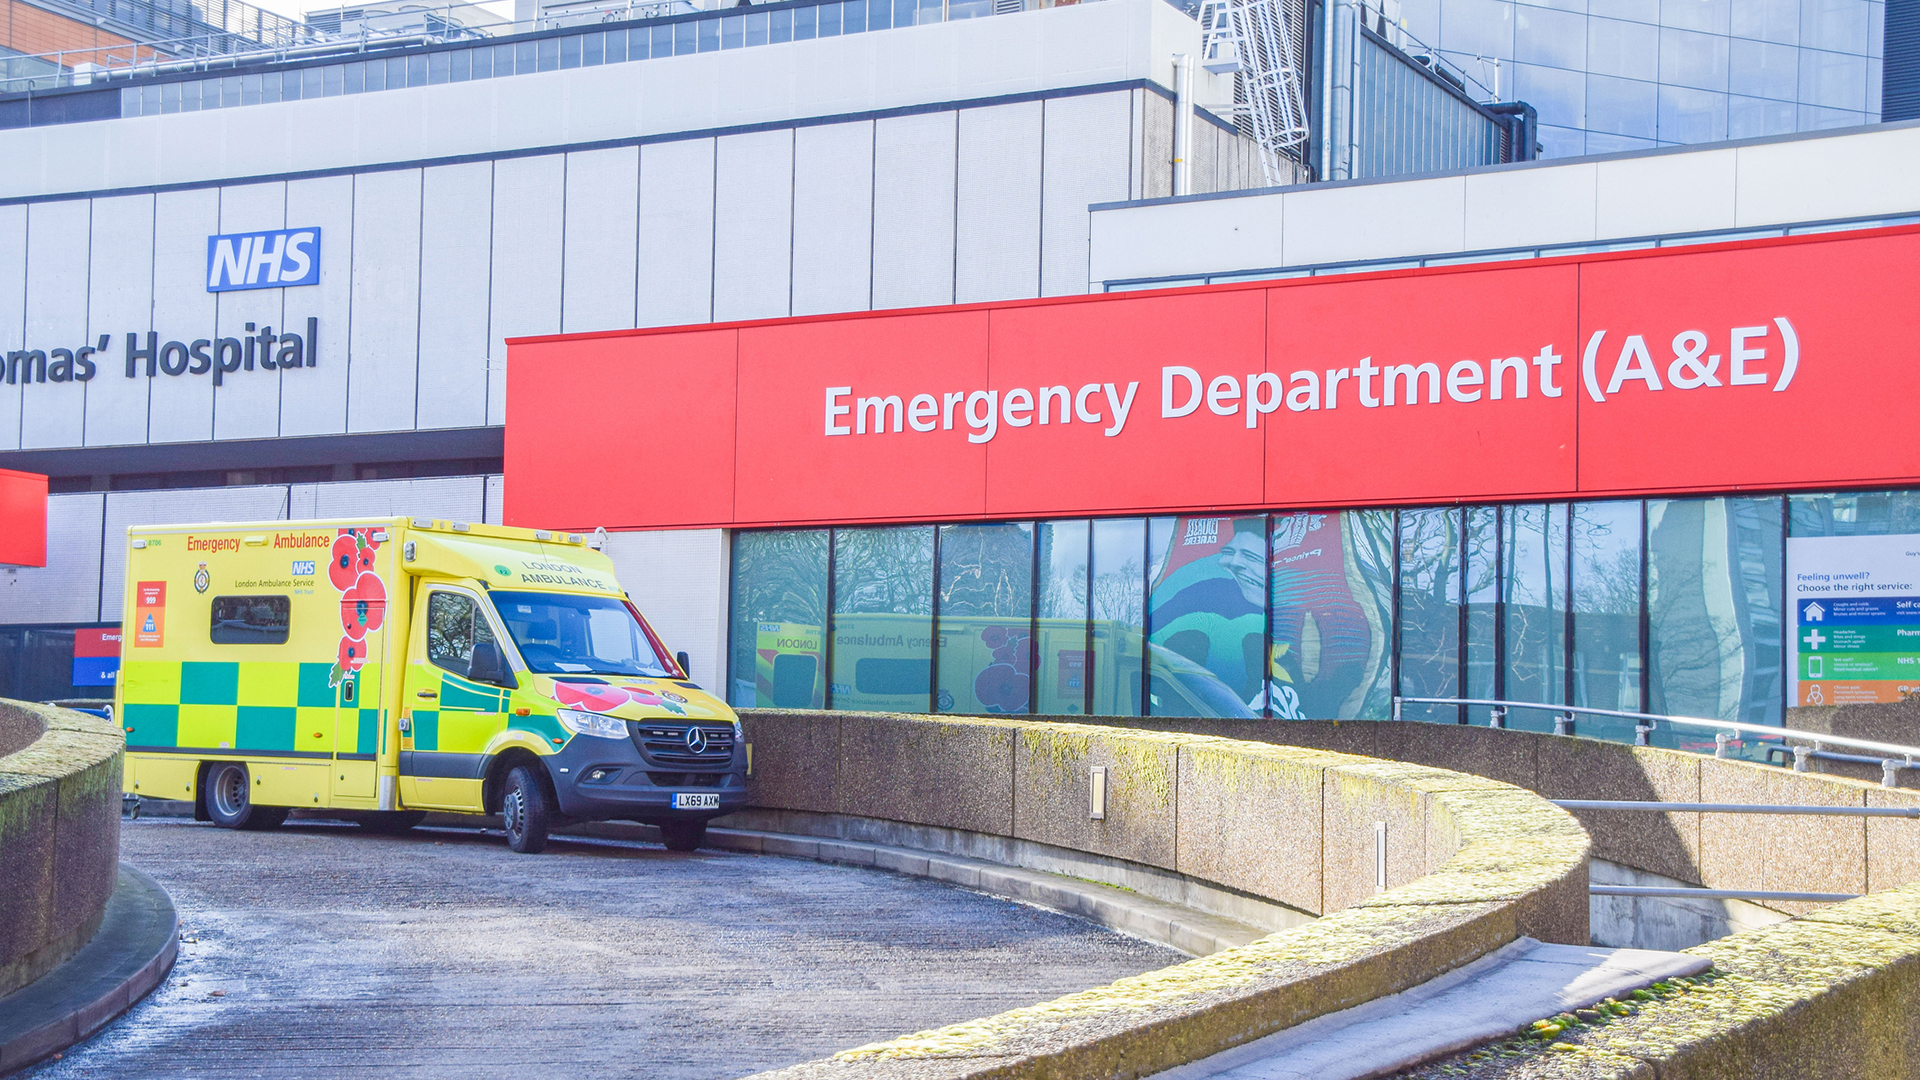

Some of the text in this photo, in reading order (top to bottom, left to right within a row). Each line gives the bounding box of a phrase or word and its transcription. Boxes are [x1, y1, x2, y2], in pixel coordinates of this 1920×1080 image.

[209, 231, 315, 287] NHS
[0, 316, 318, 386] mas' Hospital
[824, 317, 1800, 444] Emergency Department (A&E)
[187, 533, 330, 553] Emergency Ambulance
[292, 562, 314, 574] NHS
[522, 561, 582, 574] LONDON
[258, 579, 291, 587] Ambulance
[521, 574, 606, 590] AMBULANCE
[1797, 572, 1870, 582] Feeling unwell?
[1797, 582, 1913, 592] Choose the right service:
[679, 795, 702, 806] LX69
